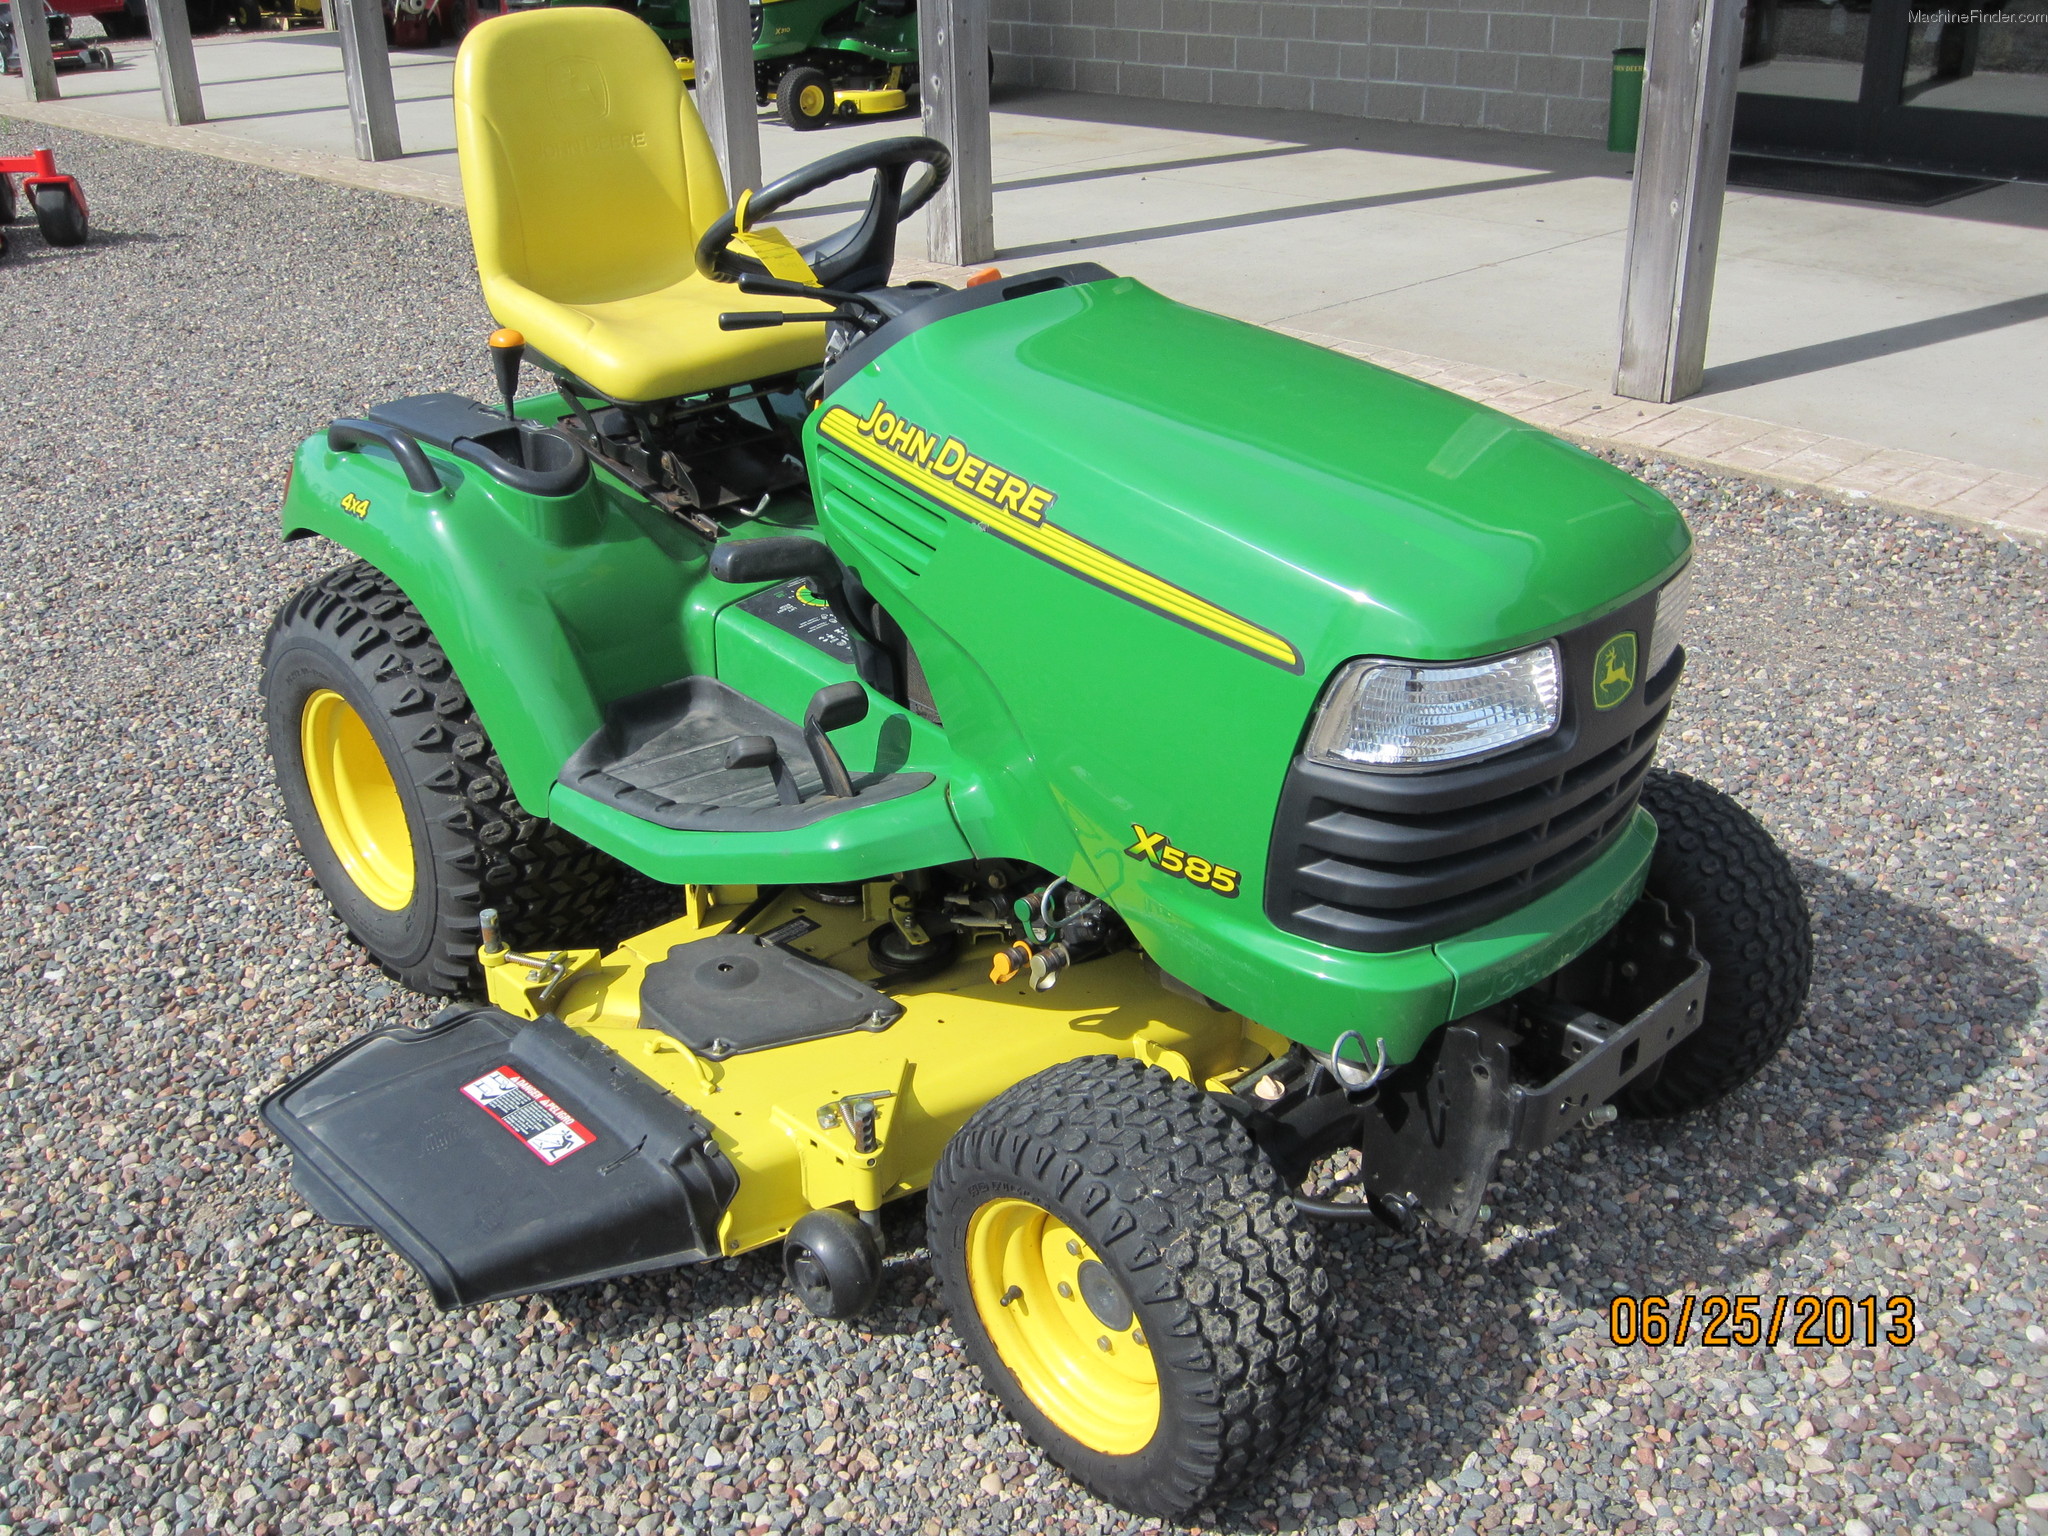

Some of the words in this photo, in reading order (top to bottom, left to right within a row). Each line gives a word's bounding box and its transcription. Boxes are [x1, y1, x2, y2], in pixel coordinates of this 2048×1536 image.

[857, 399, 941, 469] JOHN
[931, 435, 1058, 528] DEERE
[340, 492, 371, 520] 4x4
[1124, 823, 1242, 899] X585
[517, 1078, 545, 1100] DANGER
[546, 1101, 576, 1125] PELIGRO
